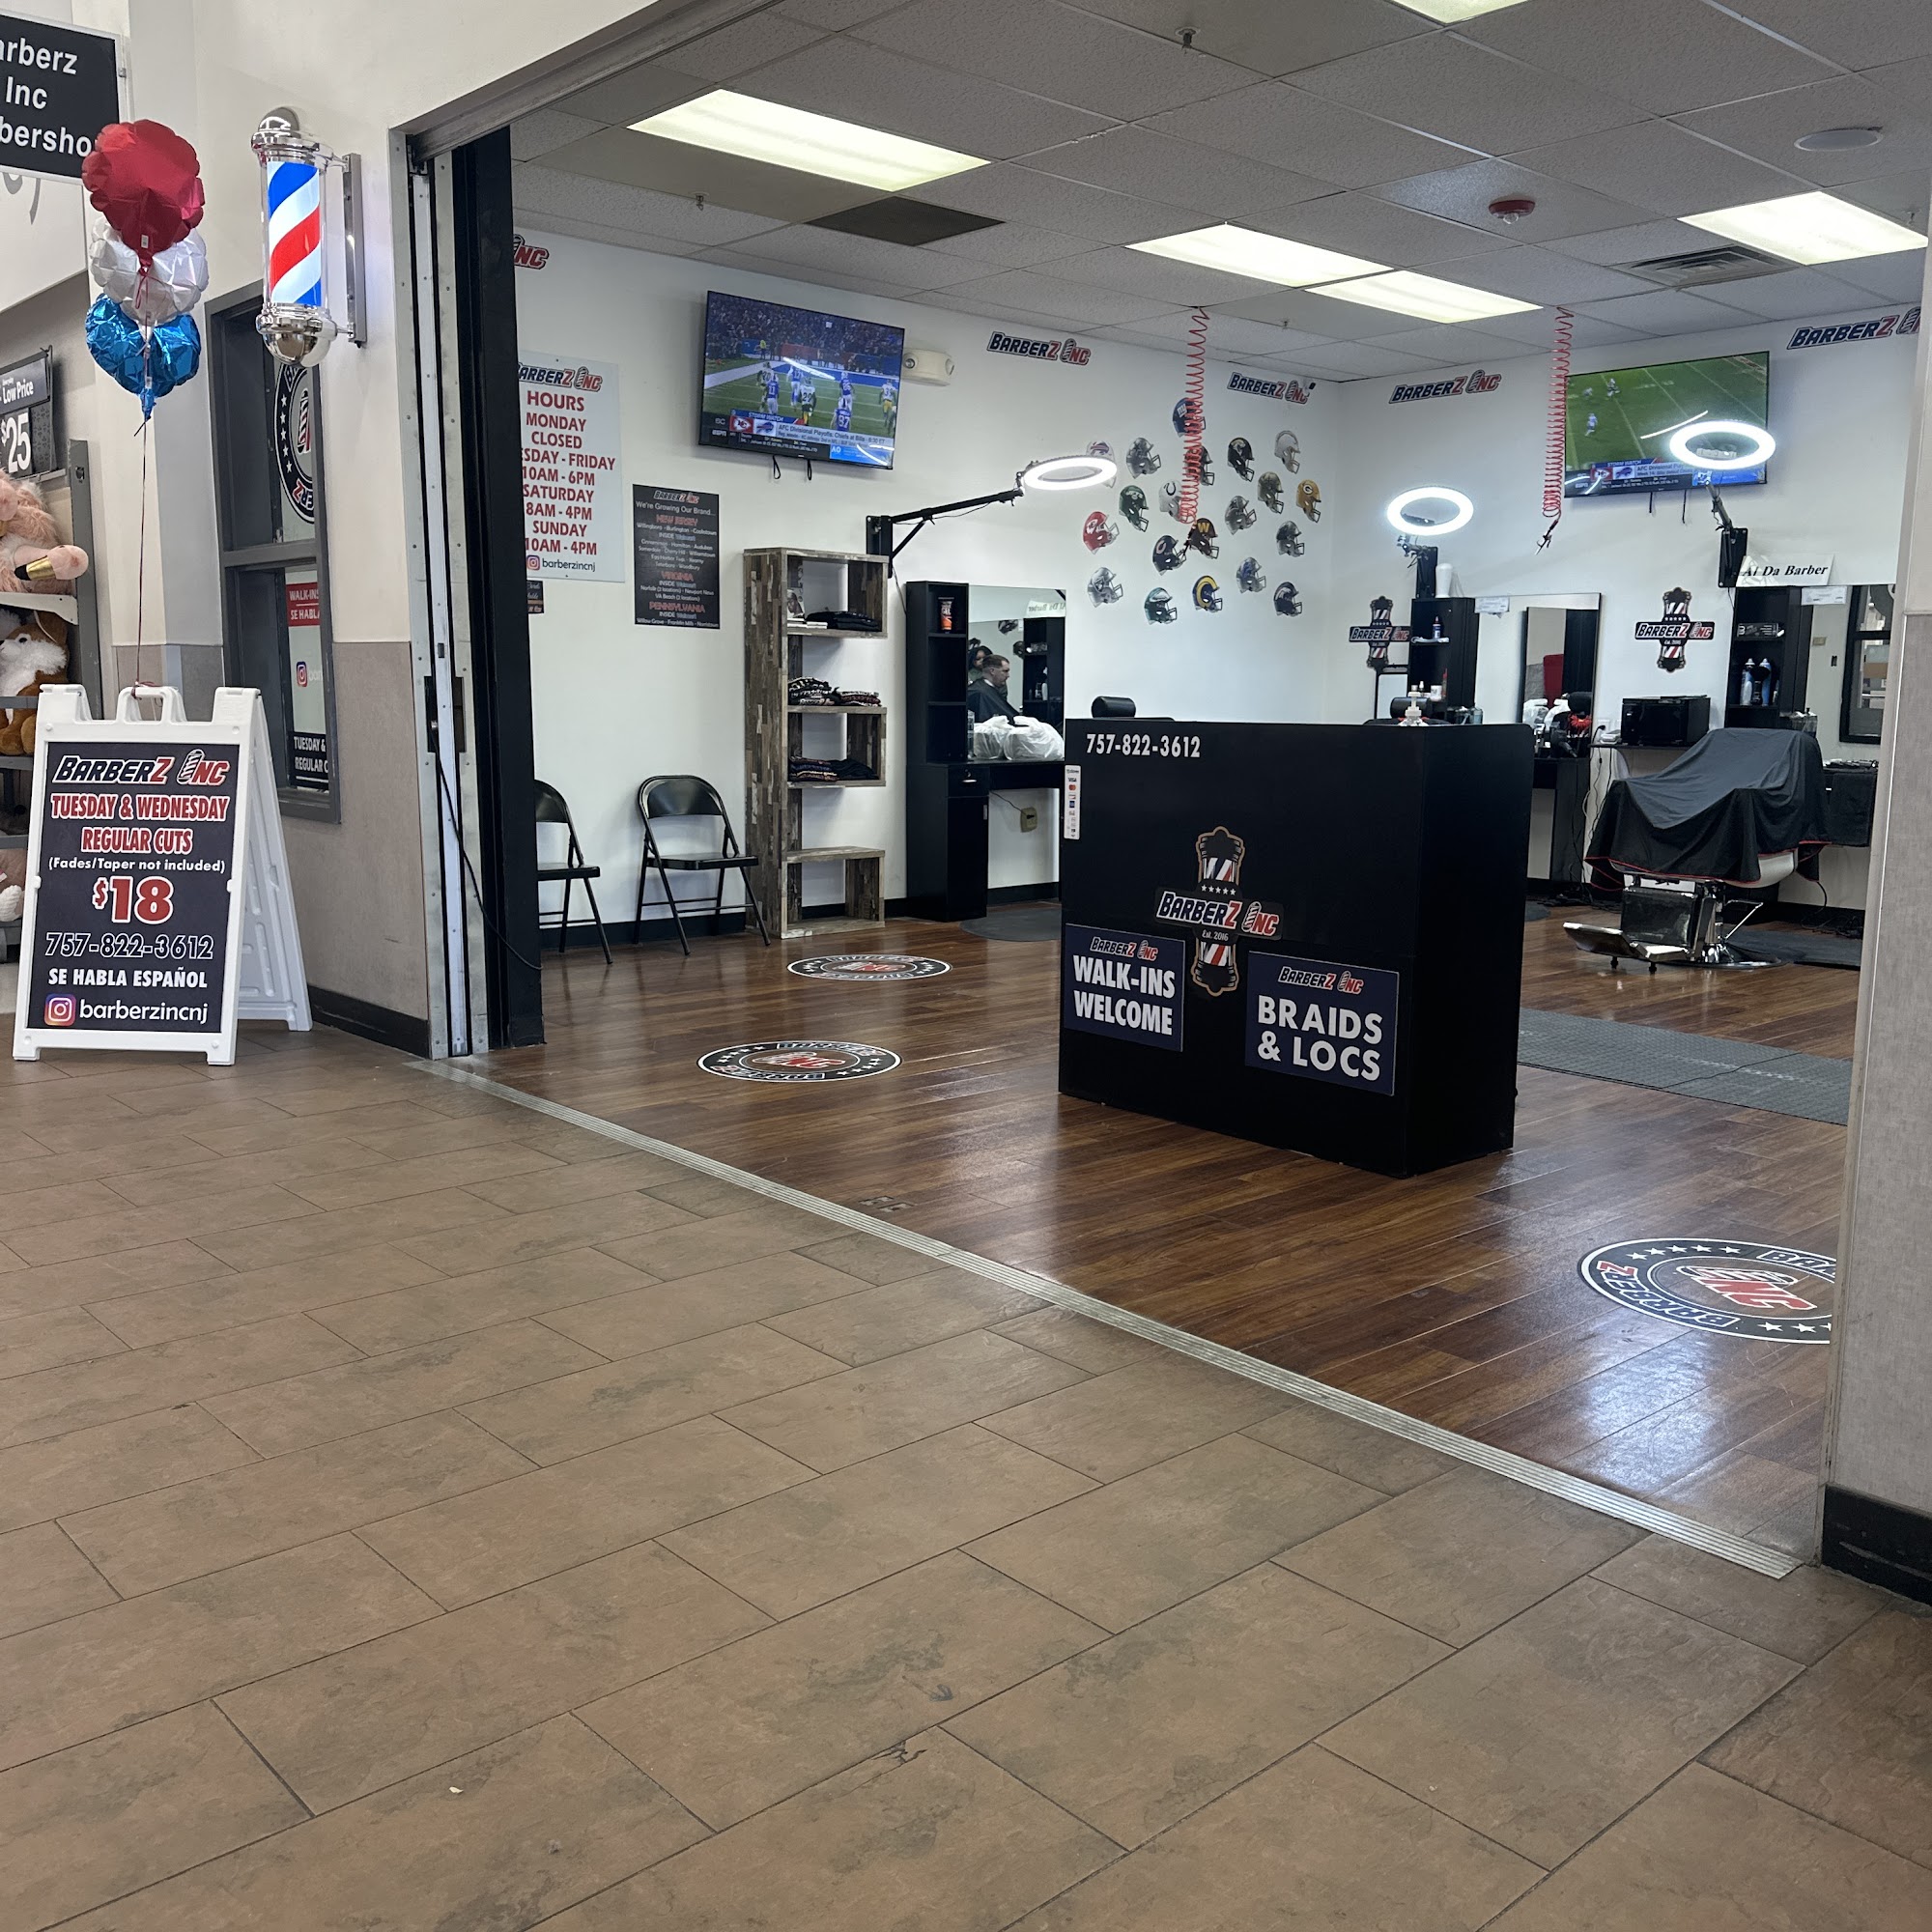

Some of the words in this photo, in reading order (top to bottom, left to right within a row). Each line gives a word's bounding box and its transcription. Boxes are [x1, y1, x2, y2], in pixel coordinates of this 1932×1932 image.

[5, 76, 47, 110] Inc
[519, 362, 576, 388] ARBERZ
[2, 387, 15, 404] Low
[16, 378, 34, 399] Price
[526, 390, 584, 412] HOURS
[526, 412, 586, 432] MONDAY
[1, 412, 31, 473] $25
[531, 431, 582, 448] CLOSED
[522, 448, 559, 465] SDAY
[569, 452, 615, 470] FRIDAY
[523, 466, 558, 482] 10AM
[568, 470, 595, 485] 6PM
[524, 483, 595, 502] SATURDAY
[526, 502, 555, 517] 8AM
[566, 506, 592, 520] 4PM
[655, 503, 680, 513] Growing
[533, 520, 587, 537] SUNDAY
[657, 514, 674, 524] NEW
[674, 516, 697, 526] JERSEY
[526, 537, 560, 553] 10AM
[570, 541, 597, 555] 4PM
[542, 558, 595, 572] barberzincnj
[1762, 565, 1779, 576] Da
[1784, 564, 1828, 576] Barber
[291, 609, 298, 620] SE
[294, 736, 321, 752] TUESDAY
[321, 738, 327, 752] &
[1086, 734, 1200, 757] 757-822-3612
[295, 756, 323, 773] REGULAR
[50, 793, 118, 819] TUESDAY
[120, 794, 134, 819] &
[135, 794, 230, 821] WEDNESDAY
[81, 827, 153, 852] REGULAR
[154, 828, 193, 854] CUTS
[48, 857, 135, 871] (Fades/Taper
[139, 860, 162, 871] not
[164, 859, 225, 874] included)
[92, 875, 174, 924] $18
[44, 931, 214, 960] 757-822-3612
[48, 968, 68, 985] SE
[73, 969, 128, 986] HABLA
[133, 966, 208, 989] ESPAÑOL
[1072, 954, 1176, 999] WALK-INS
[79, 999, 209, 1024] barberzincnj
[1074, 990, 1173, 1036] WELCOME
[1258, 995, 1383, 1045] BRAIDS
[1258, 1030, 1281, 1062] &
[1293, 1036, 1380, 1081] LOCS
